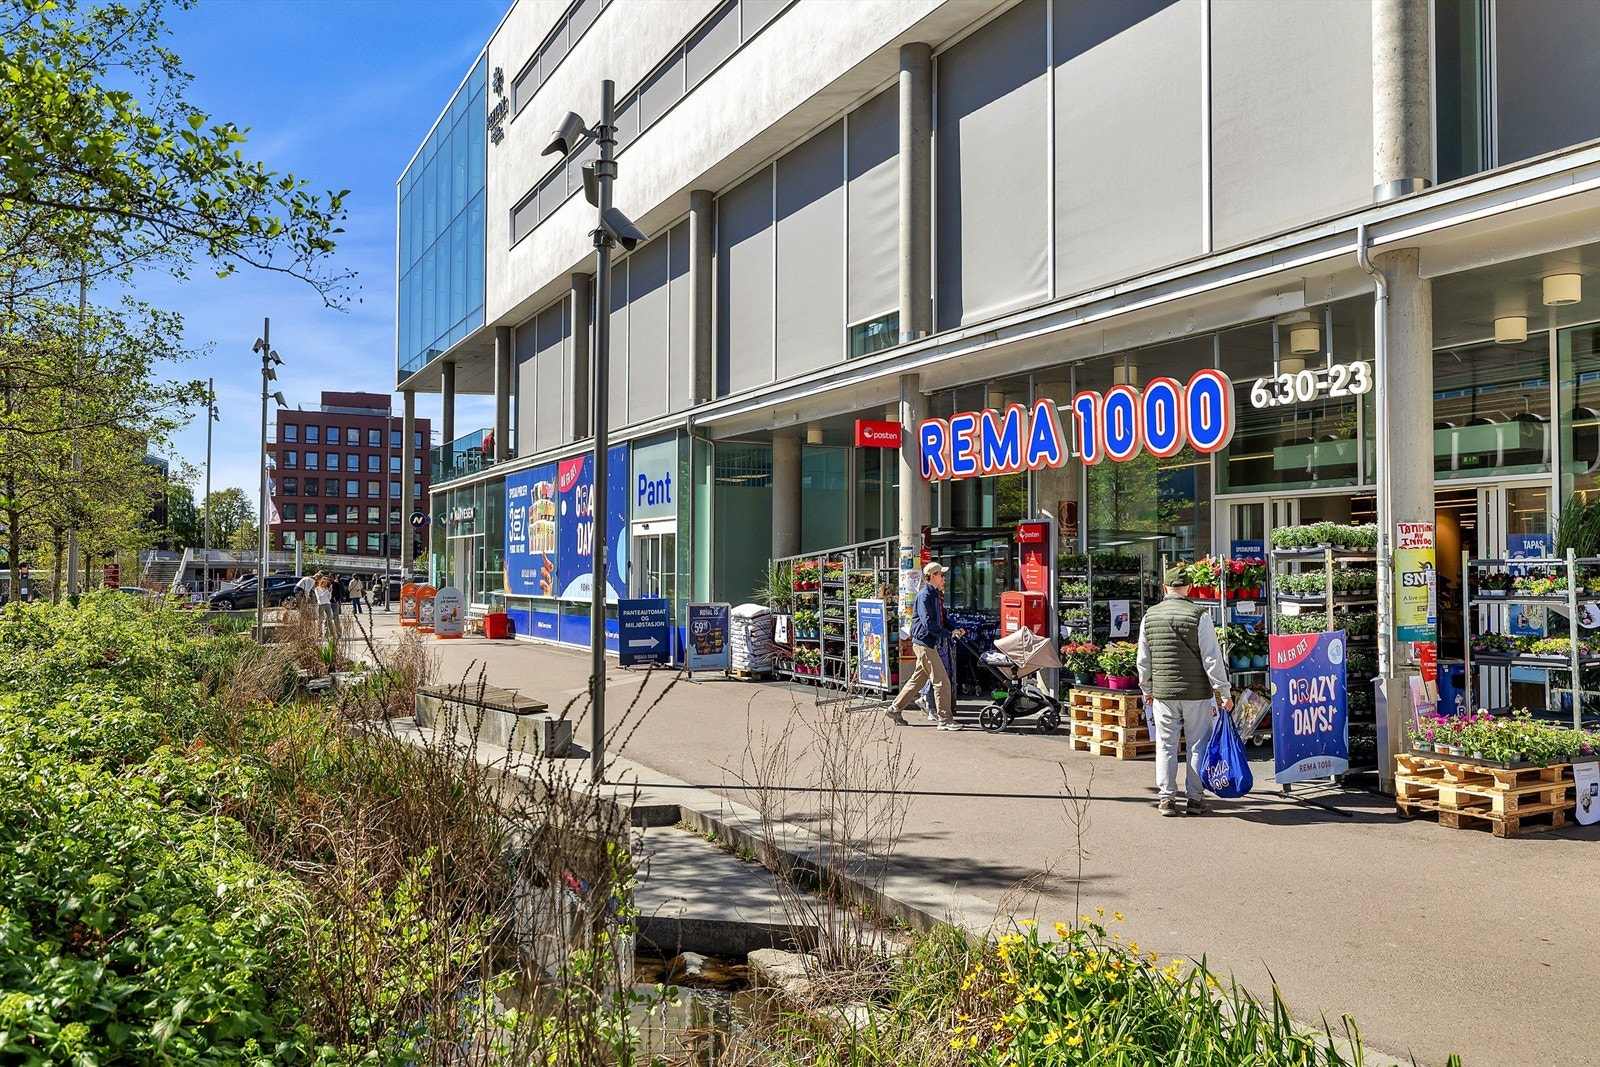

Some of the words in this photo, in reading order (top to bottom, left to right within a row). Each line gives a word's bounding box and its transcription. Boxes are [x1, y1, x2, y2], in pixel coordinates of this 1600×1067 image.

[1251, 361, 1371, 408] 6.30-23
[919, 399, 1066, 482] REMA
[1073, 369, 1233, 465] 1000
[575, 484, 594, 518] CRA
[638, 472, 672, 507] Pant
[577, 521, 594, 556] DAY
[1523, 540, 1544, 550] TAPAS
[1404, 572, 1428, 587] SN
[1277, 651, 1287, 664] NÅ
[1288, 648, 1297, 662] ER
[1297, 638, 1309, 656] DET
[1288, 674, 1337, 706] CRAZY
[1293, 704, 1335, 736] DAYS!
[1300, 762, 1317, 773] REMA
